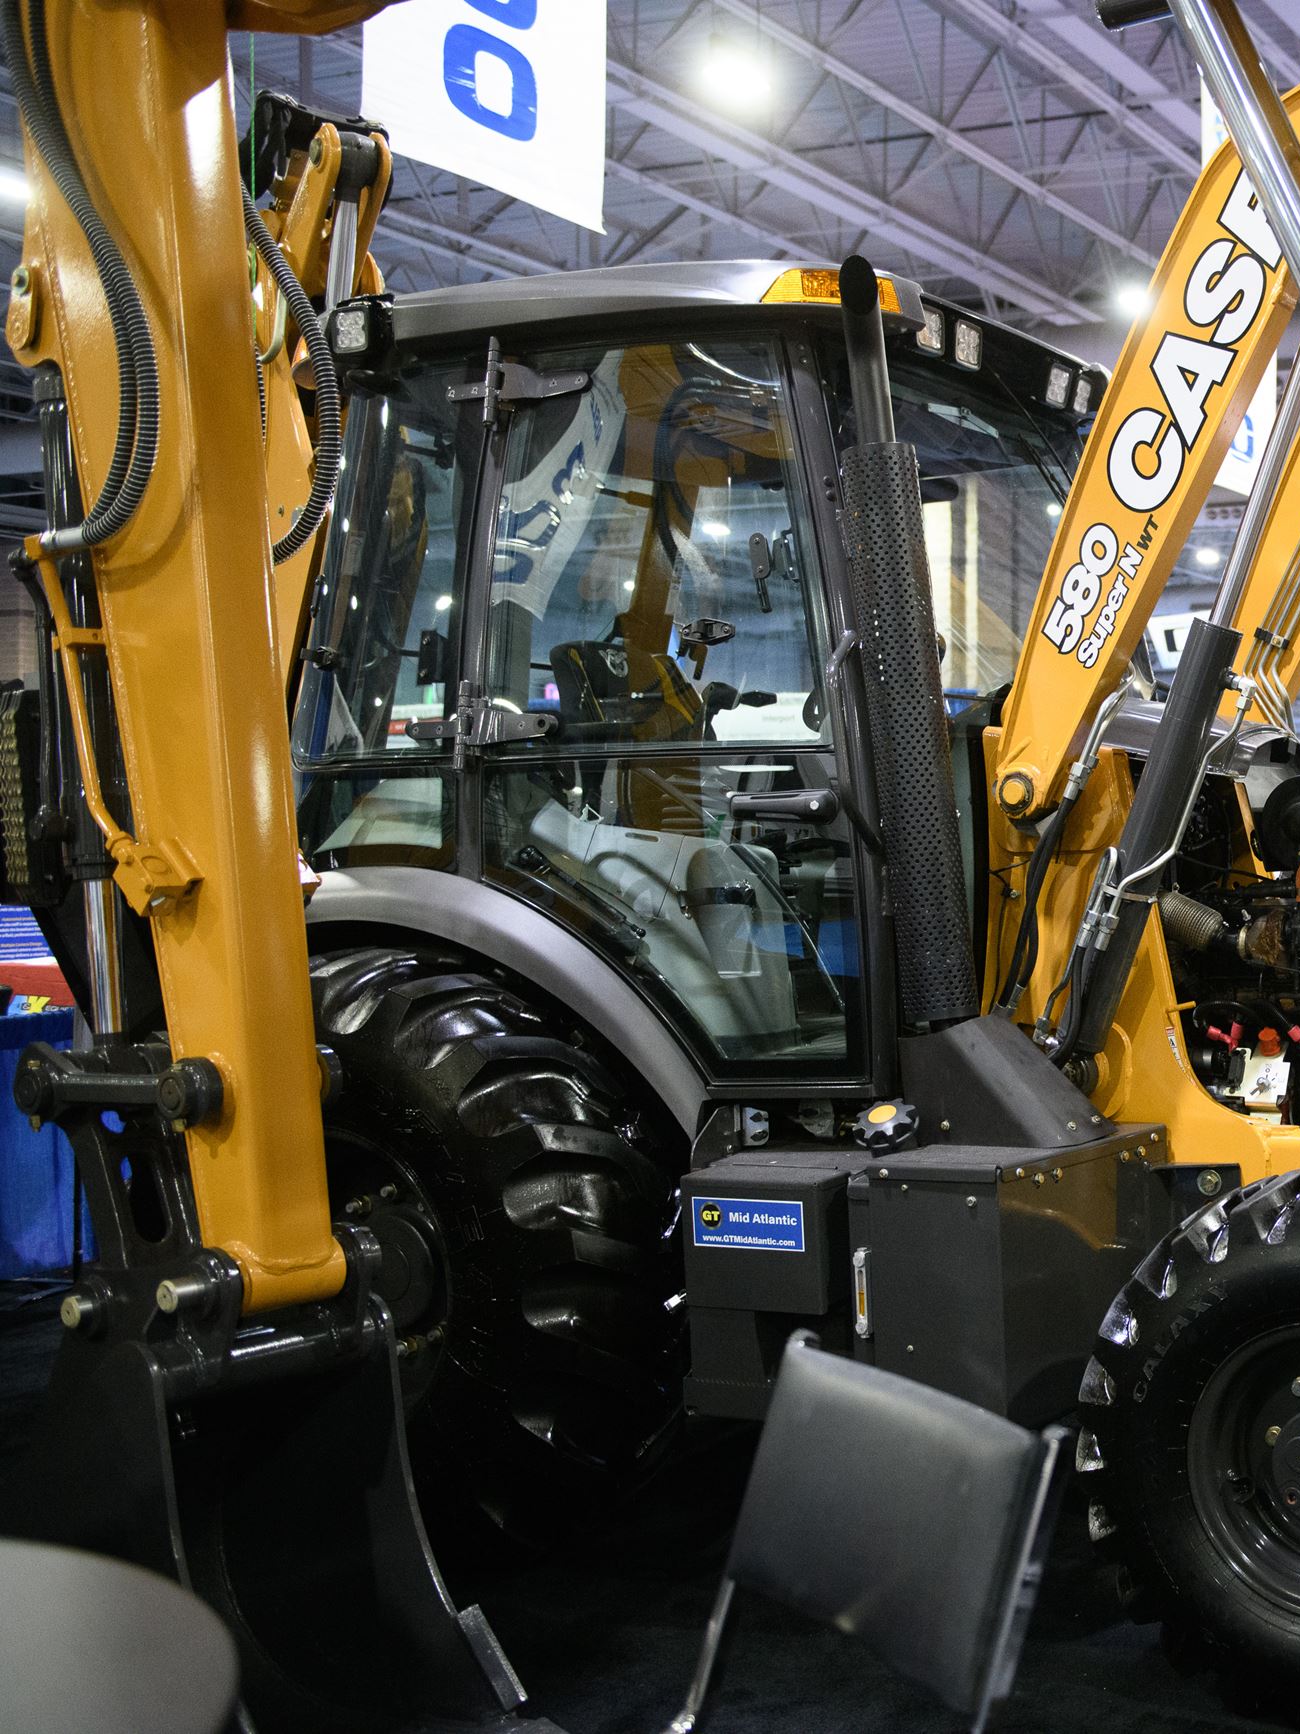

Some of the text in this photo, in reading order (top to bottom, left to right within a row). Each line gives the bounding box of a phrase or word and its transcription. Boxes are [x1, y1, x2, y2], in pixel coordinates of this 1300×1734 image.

[1041, 522, 1119, 654] 580
[1077, 514, 1158, 669] Super N WT
[702, 1210, 798, 1226] GT Mid Atlantic
[702, 1235, 796, 1246] www.GTMidAtlantic.com
